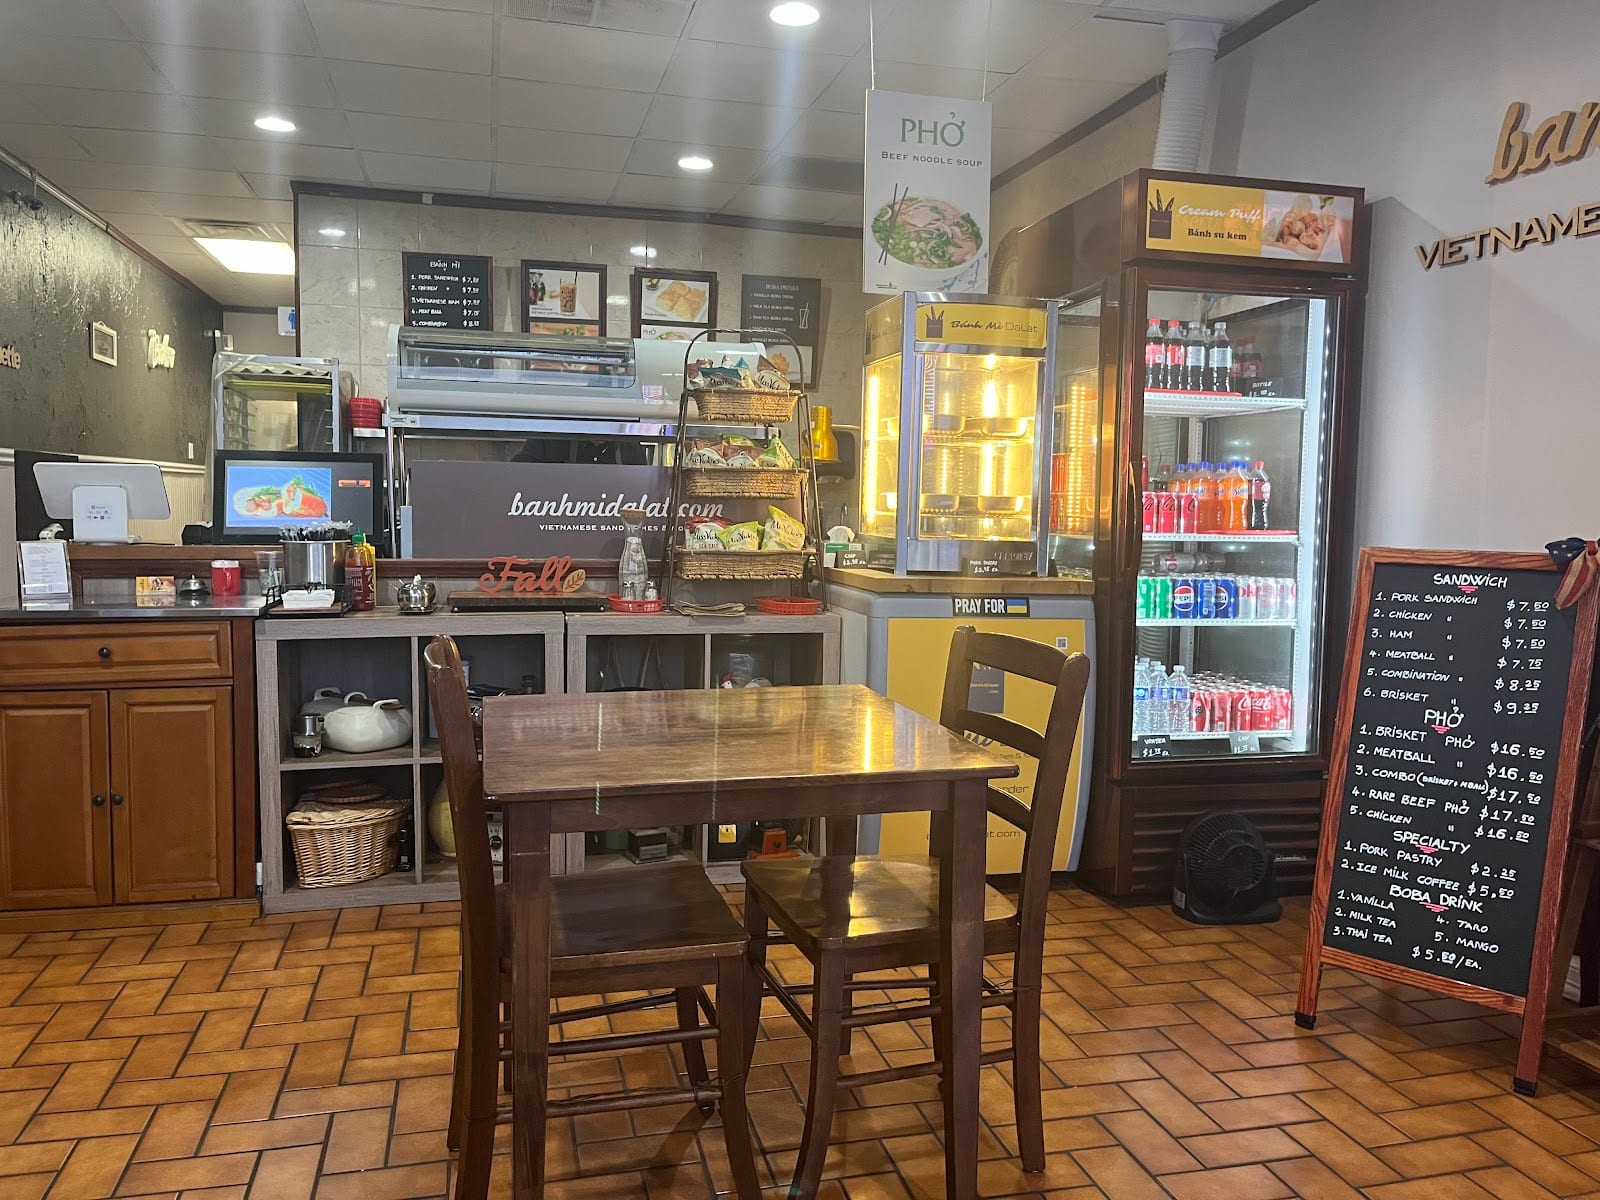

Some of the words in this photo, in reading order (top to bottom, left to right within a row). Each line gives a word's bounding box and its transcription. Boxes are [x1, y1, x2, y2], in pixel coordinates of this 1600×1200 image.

[900, 112, 966, 147] PHỞ
[912, 155, 953, 165] NOODLE
[956, 159, 983, 167] SOUP
[1178, 205, 1225, 217] Cream
[1229, 208, 1260, 223] Puff
[1188, 229, 1211, 238] Bánh
[1227, 232, 1247, 241] kem
[950, 321, 983, 329] Bánh
[1006, 323, 1037, 333] DaLat
[479, 555, 573, 593] Fall
[954, 599, 981, 614] PRAY
[984, 599, 1006, 614] FOR
[1376, 592, 1387, 602] 1.
[1391, 592, 1420, 603] PORK
[1373, 608, 1384, 618] 2.
[1371, 628, 1382, 638] 3.
[1390, 630, 1413, 639] HAM
[1369, 650, 1381, 658] 4.
[1386, 650, 1435, 661] MEATBALL
[1367, 667, 1378, 677] 5.
[1363, 687, 1375, 697] 6.
[1424, 706, 1464, 727] PHỞ
[1360, 724, 1371, 735] 1.
[1490, 741, 1545, 759] $16.50
[1357, 744, 1370, 755] 2.
[1374, 746, 1436, 764] MEATBALL
[1487, 763, 1543, 784] $16.50
[1355, 765, 1368, 776] 3.
[1487, 787, 1541, 804] $17.50
[1352, 786, 1365, 797] 4.
[1368, 788, 1396, 802] RARE
[1401, 794, 1436, 809] BEEF
[1479, 807, 1535, 825] $17.50
[1350, 806, 1362, 815] 5.
[1474, 825, 1530, 840] $16.50
[1393, 830, 1471, 855] SPECIALTY
[1344, 840, 1357, 852] 1.
[1359, 843, 1389, 858] PORK
[1397, 850, 1443, 867] PASTRY
[1356, 862, 1377, 874] ICE
[1416, 875, 1460, 892] COFFEE
[1389, 885, 1431, 903] BOBA
[1335, 907, 1347, 917] 2.
[1349, 910, 1373, 923] MILK
[1377, 916, 1397, 928] TEA
[1436, 915, 1449, 924] 4.
[1457, 920, 1489, 933] TARO
[1332, 926, 1344, 936] 3.
[1373, 934, 1393, 945] TEA
[1434, 931, 1449, 942] 5.
[1456, 937, 1499, 953] MANGO
